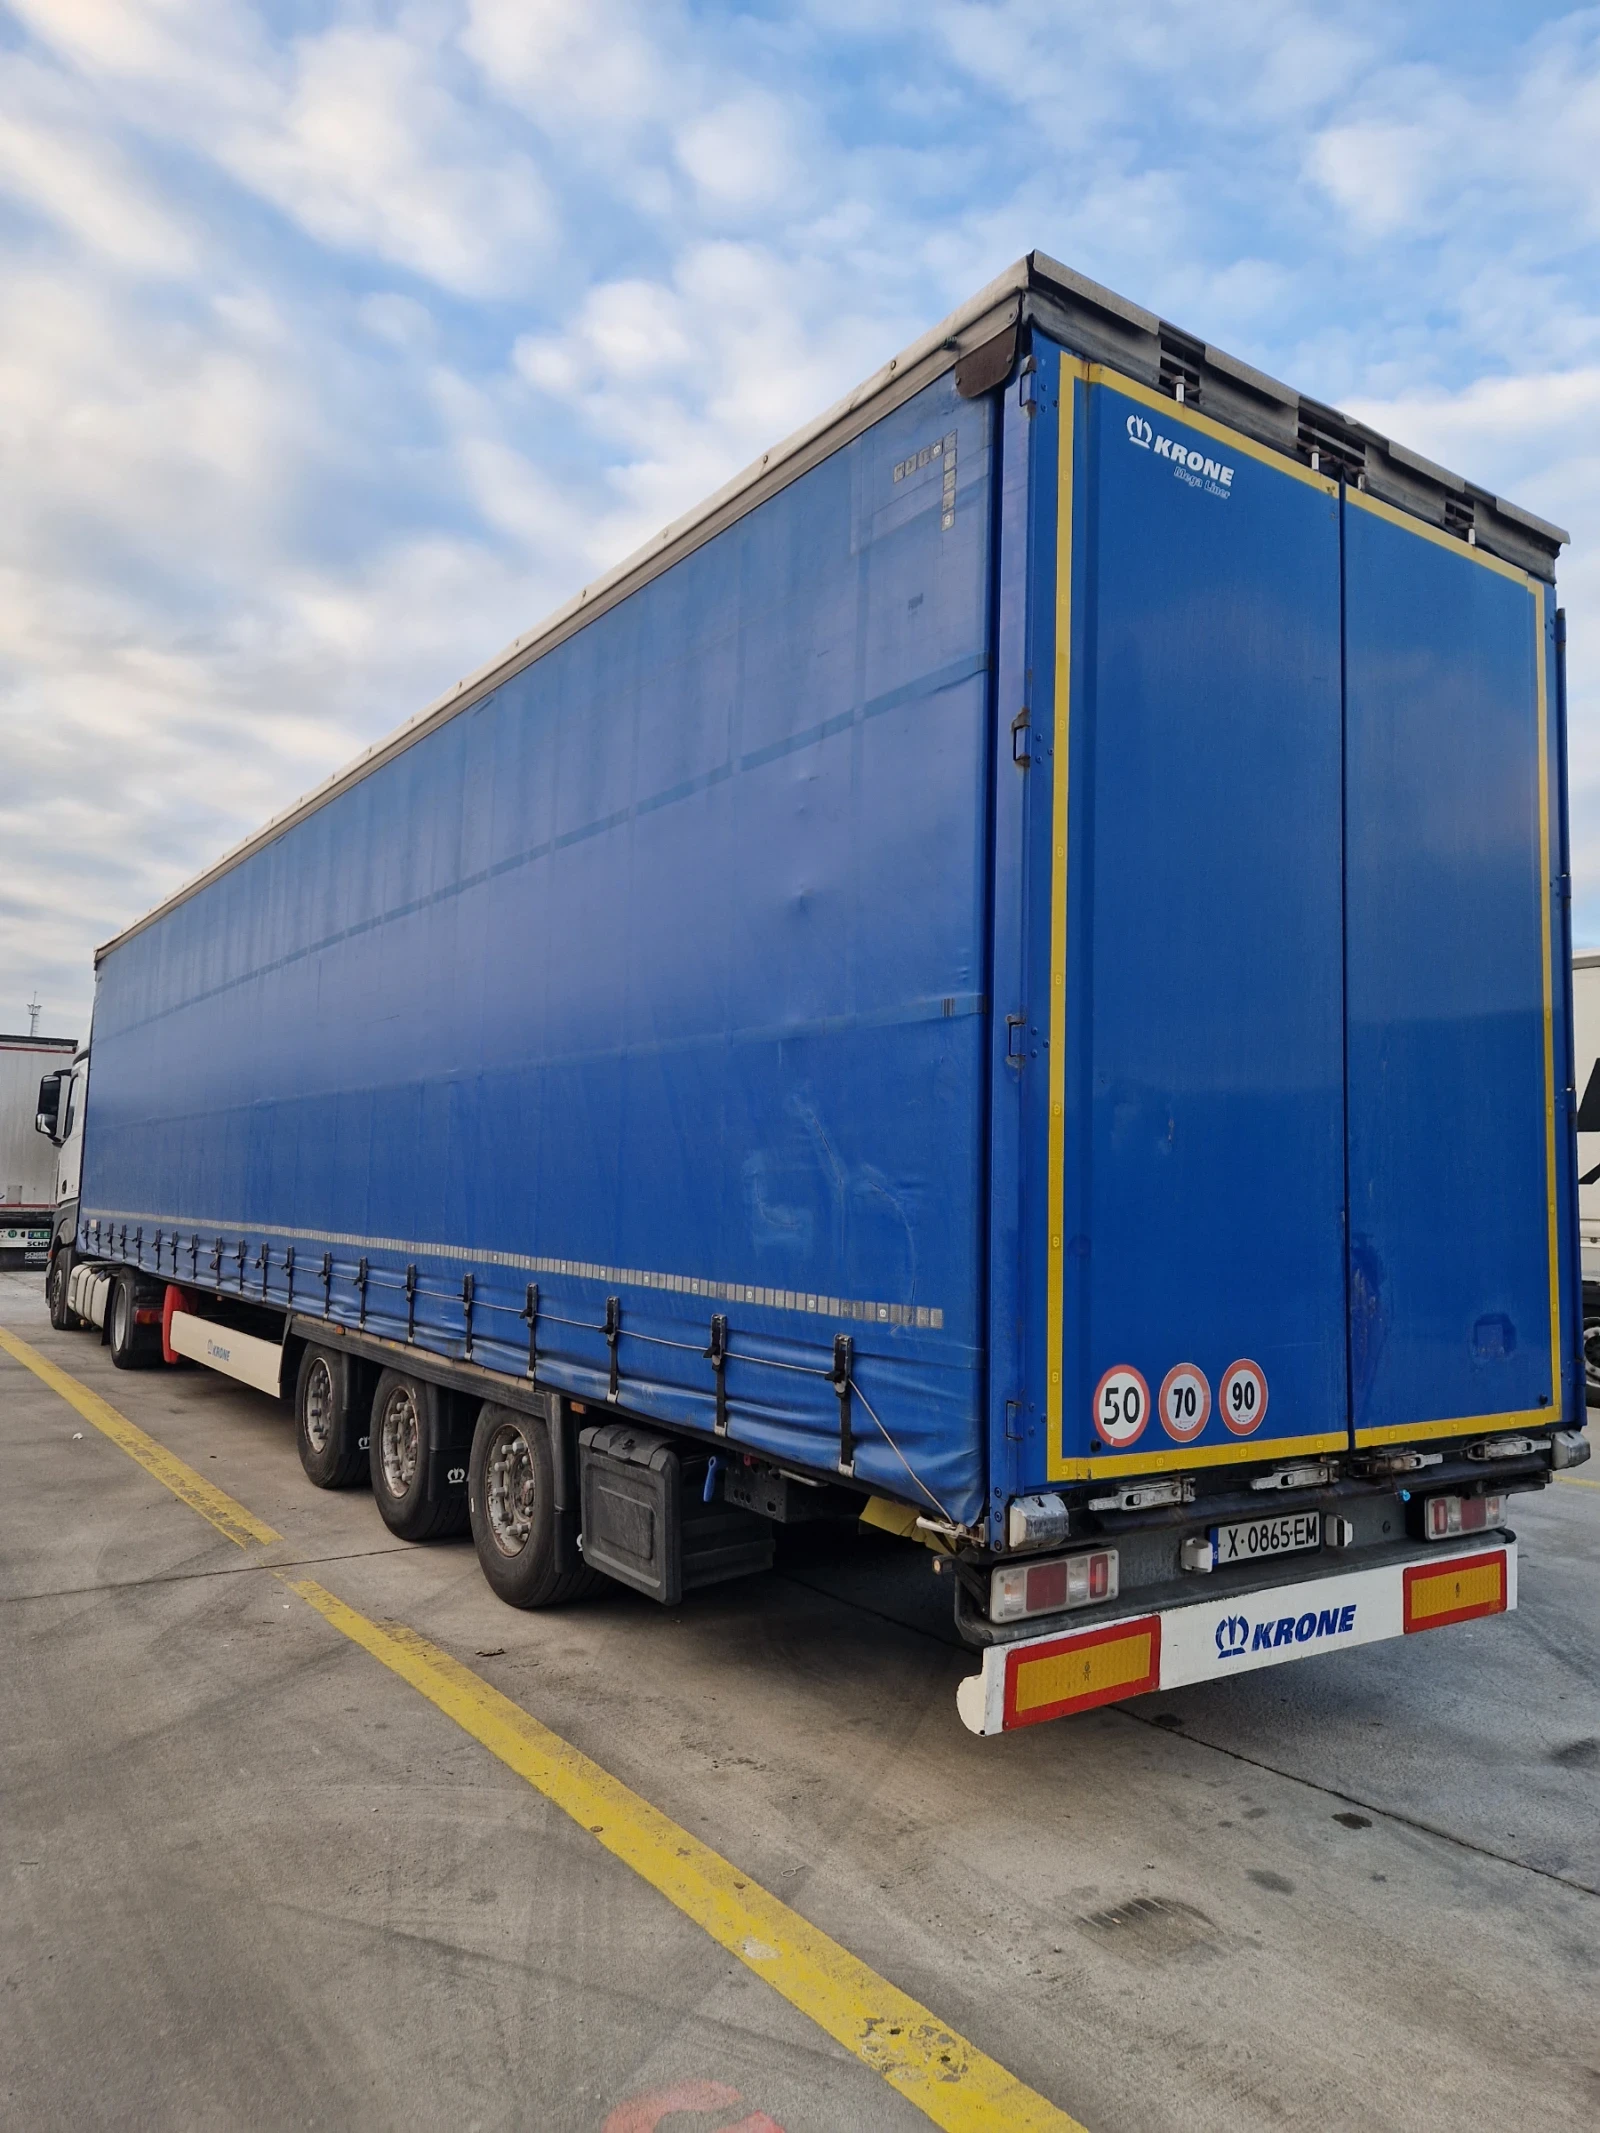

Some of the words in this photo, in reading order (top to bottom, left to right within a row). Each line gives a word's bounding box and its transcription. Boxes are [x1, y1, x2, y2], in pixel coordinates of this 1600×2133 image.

[1154, 435, 1235, 487] KRONE
[1173, 466, 1203, 487] Mega
[1204, 480, 1231, 499] Liner
[212, 1345, 231, 1361] KRONE
[1103, 1386, 1140, 1425] 50
[1173, 1387, 1196, 1419] 70
[1232, 1381, 1255, 1411] 90
[1251, 1604, 1357, 1652] KRONE
